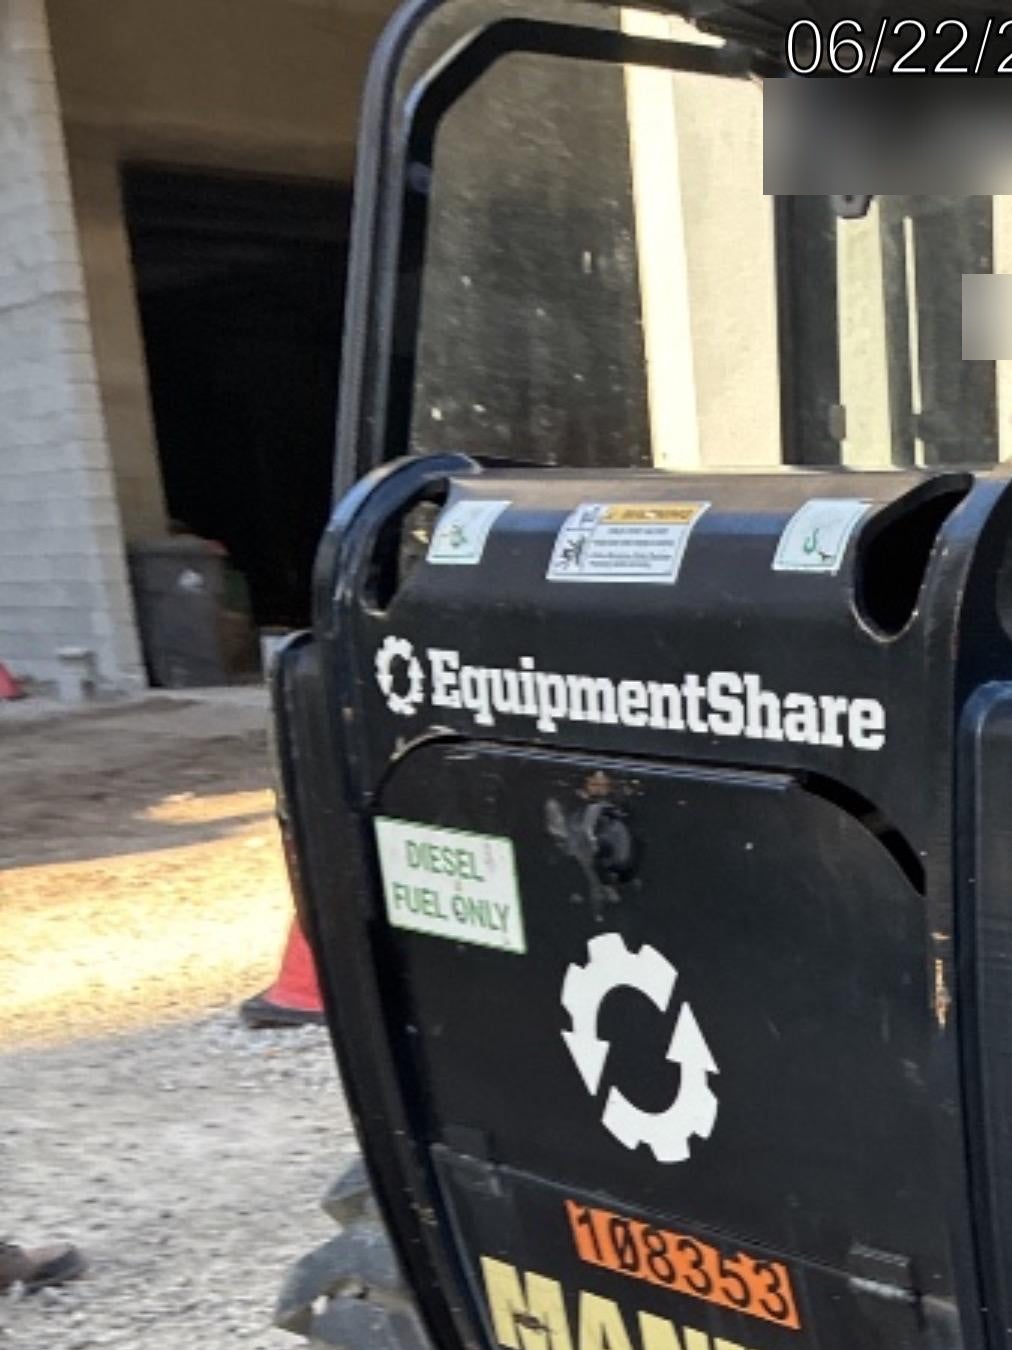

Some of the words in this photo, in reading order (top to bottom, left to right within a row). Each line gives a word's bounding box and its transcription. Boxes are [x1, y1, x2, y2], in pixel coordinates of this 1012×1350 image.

[427, 648, 887, 749] EquipmentShare
[405, 839, 485, 882] DIESEL
[392, 881, 448, 920] FUEL
[451, 893, 510, 933] ONLY
[572, 1205, 792, 1322] 108353
